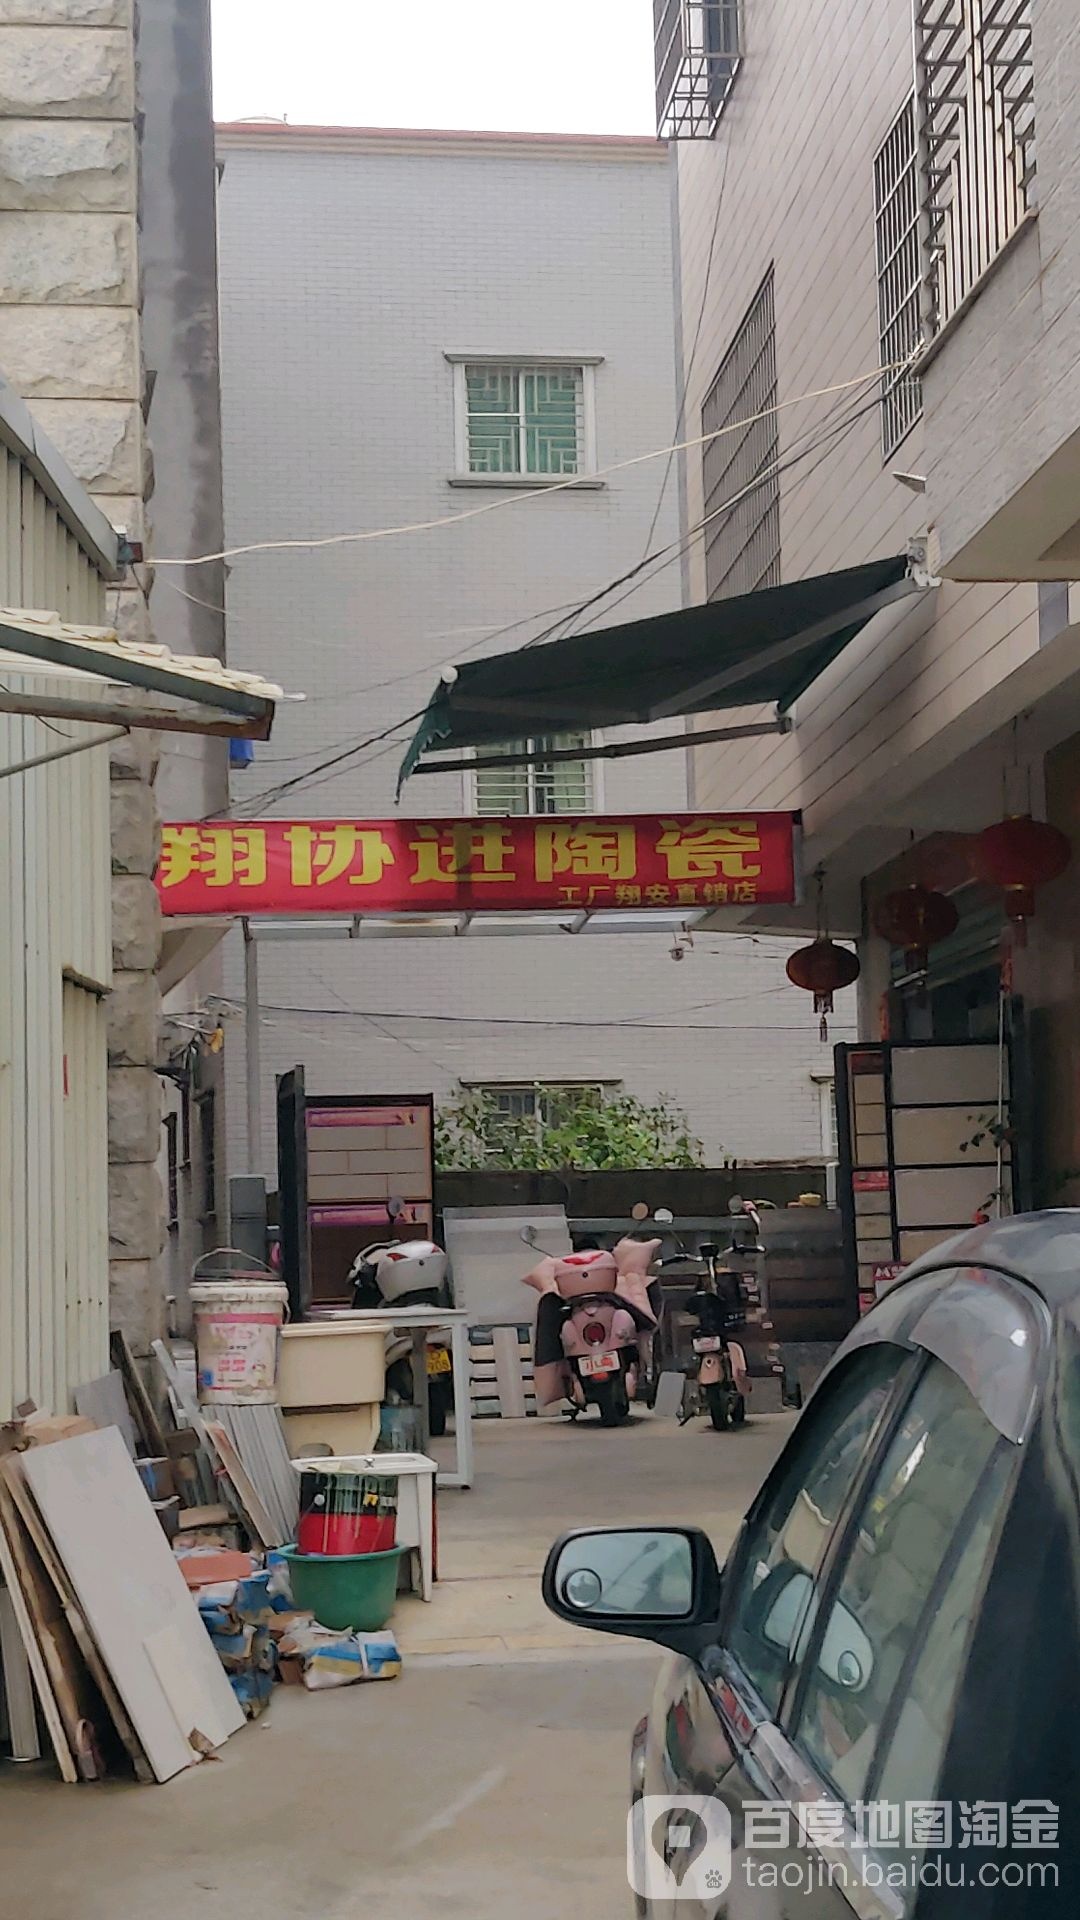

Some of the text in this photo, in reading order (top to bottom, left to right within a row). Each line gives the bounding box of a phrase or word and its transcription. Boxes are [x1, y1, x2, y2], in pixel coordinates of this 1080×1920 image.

[160, 819, 761, 888] 翔协进陶瓷
[557, 881, 757, 906] 工厂翔安直销店
